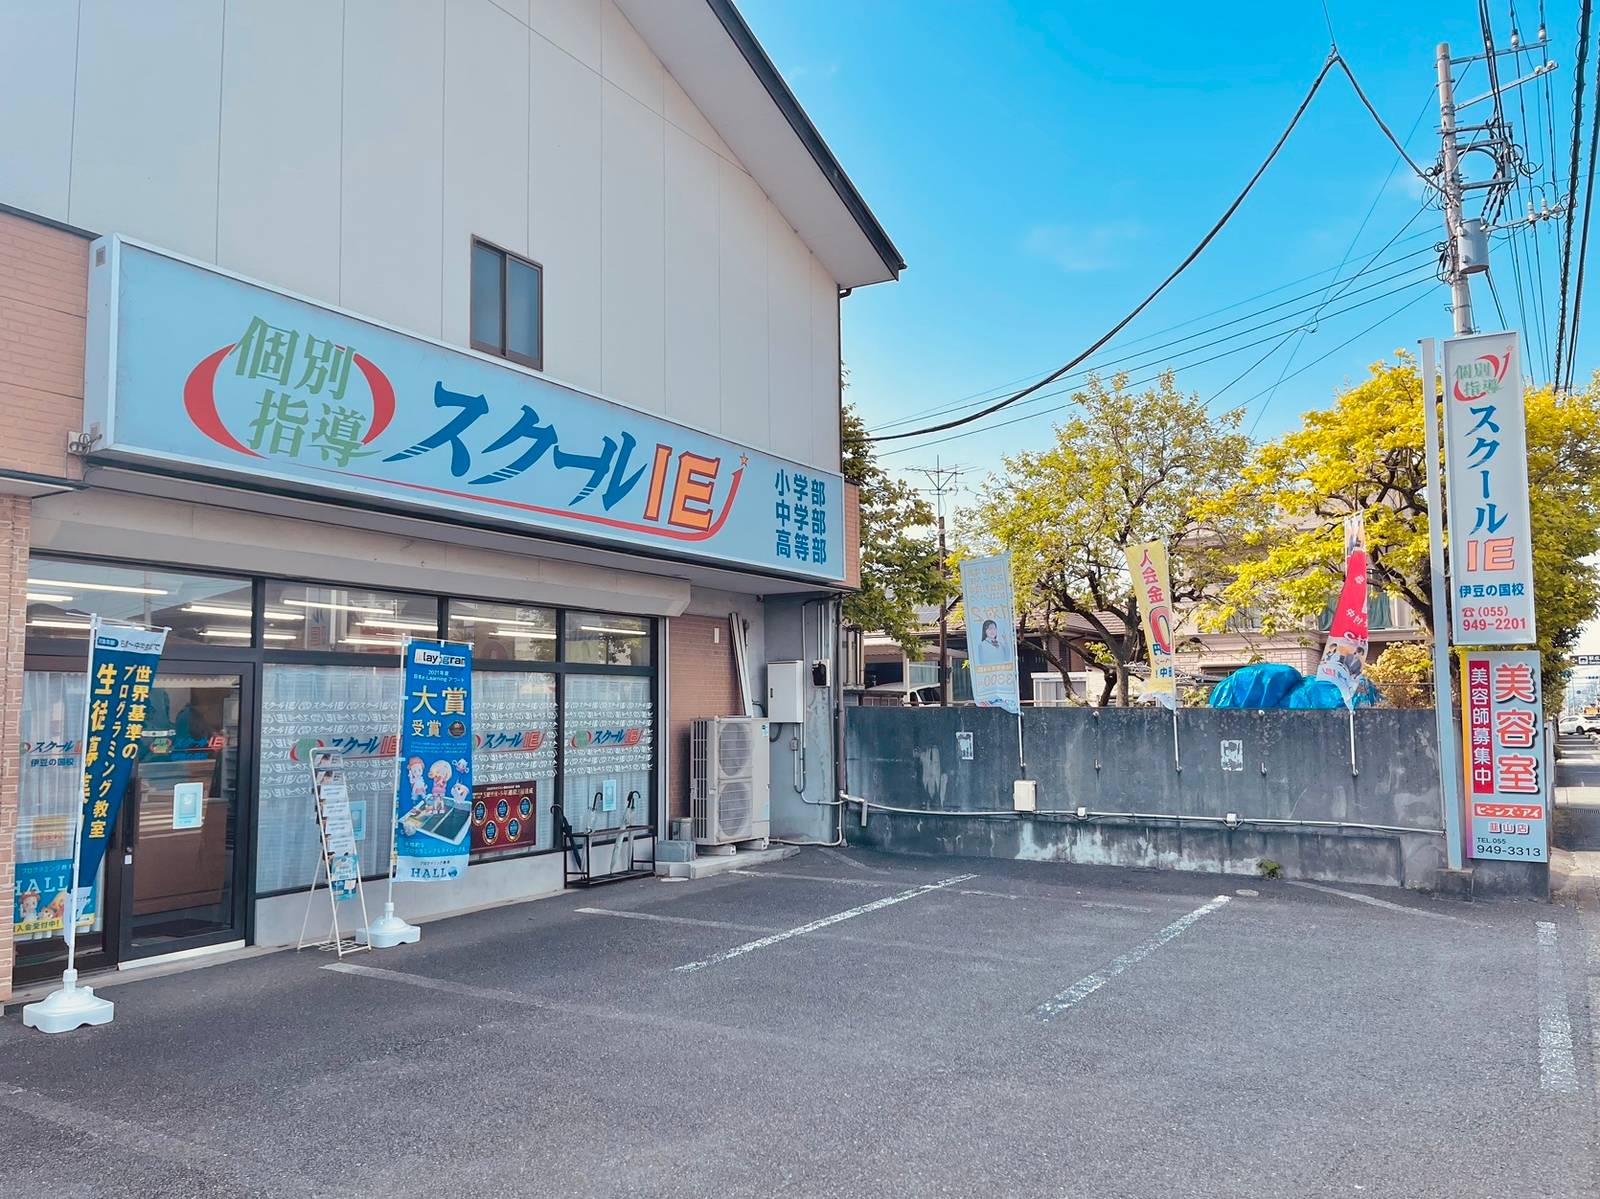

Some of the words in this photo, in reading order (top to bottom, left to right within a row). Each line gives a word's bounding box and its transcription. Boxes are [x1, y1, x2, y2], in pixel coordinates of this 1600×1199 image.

[230, 315, 356, 400] 個別
[246, 388, 380, 468] 指導
[774, 468, 827, 506] 小学部
[775, 499, 827, 536] 中学部
[775, 529, 827, 565] 高等部
[1459, 582, 1525, 599] 伊豆の国校
[1462, 618, 1527, 632] 949-2201
[121, 665, 153, 760] 世界基準の
[411, 685, 467, 716] 大賞
[411, 719, 441, 738] 受賞
[1470, 667, 1492, 786] 美容師募集中
[1494, 663, 1538, 795] 美容室
[88, 664, 138, 838] プログラミング教室
[1476, 846, 1541, 857] 949-3313
